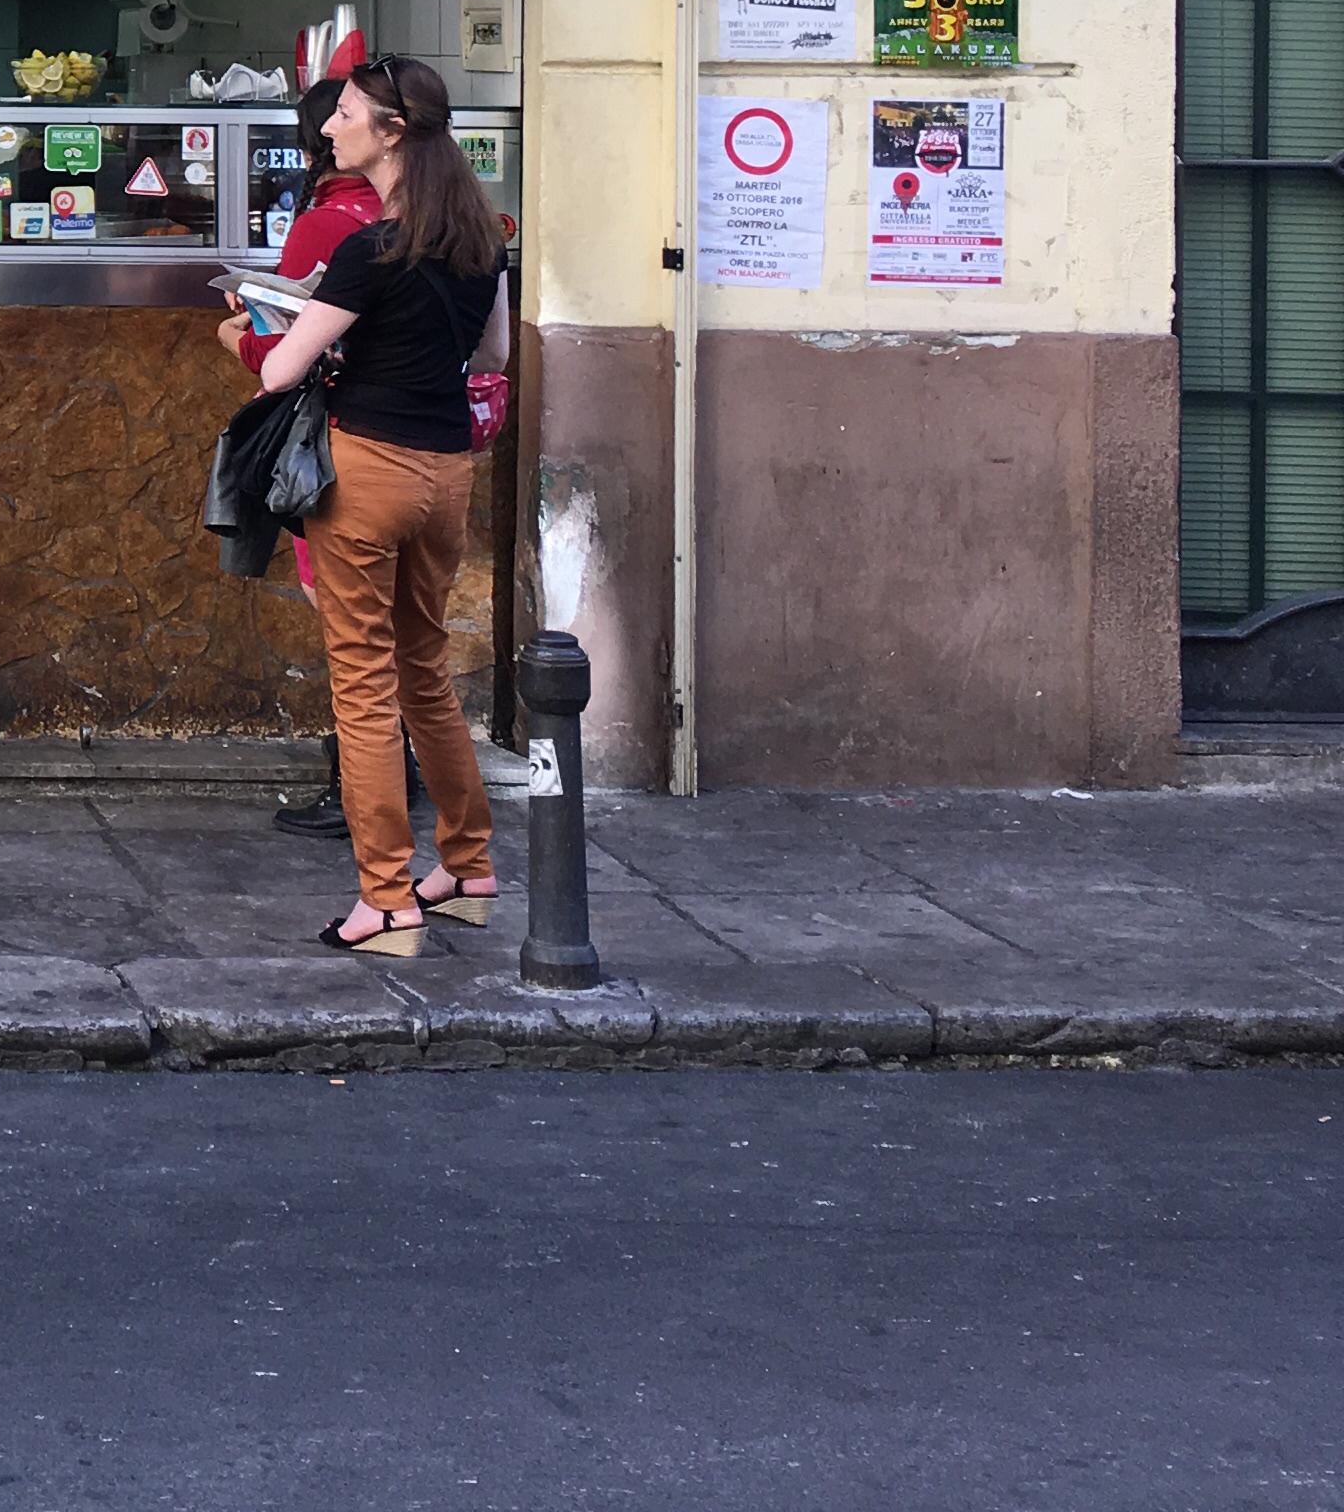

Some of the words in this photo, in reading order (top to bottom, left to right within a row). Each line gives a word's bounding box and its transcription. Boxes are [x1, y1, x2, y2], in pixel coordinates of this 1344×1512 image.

[880, 44, 1011, 55] KALAKUTA
[975, 111, 995, 127] 27
[918, 130, 961, 145] Festa
[712, 192, 724, 201] 25
[726, 193, 777, 204] OTTOBRE
[780, 196, 803, 205] 2016
[952, 188, 988, 199] JAKA
[730, 206, 785, 217] SCIOPERO
[53, 218, 94, 228] Palermo
[727, 219, 772, 230] CONTRO
[774, 222, 788, 230] LA
[892, 236, 935, 244] INGRESSO
[938, 237, 981, 245] GRATUITO
[729, 258, 750, 267] ORE
